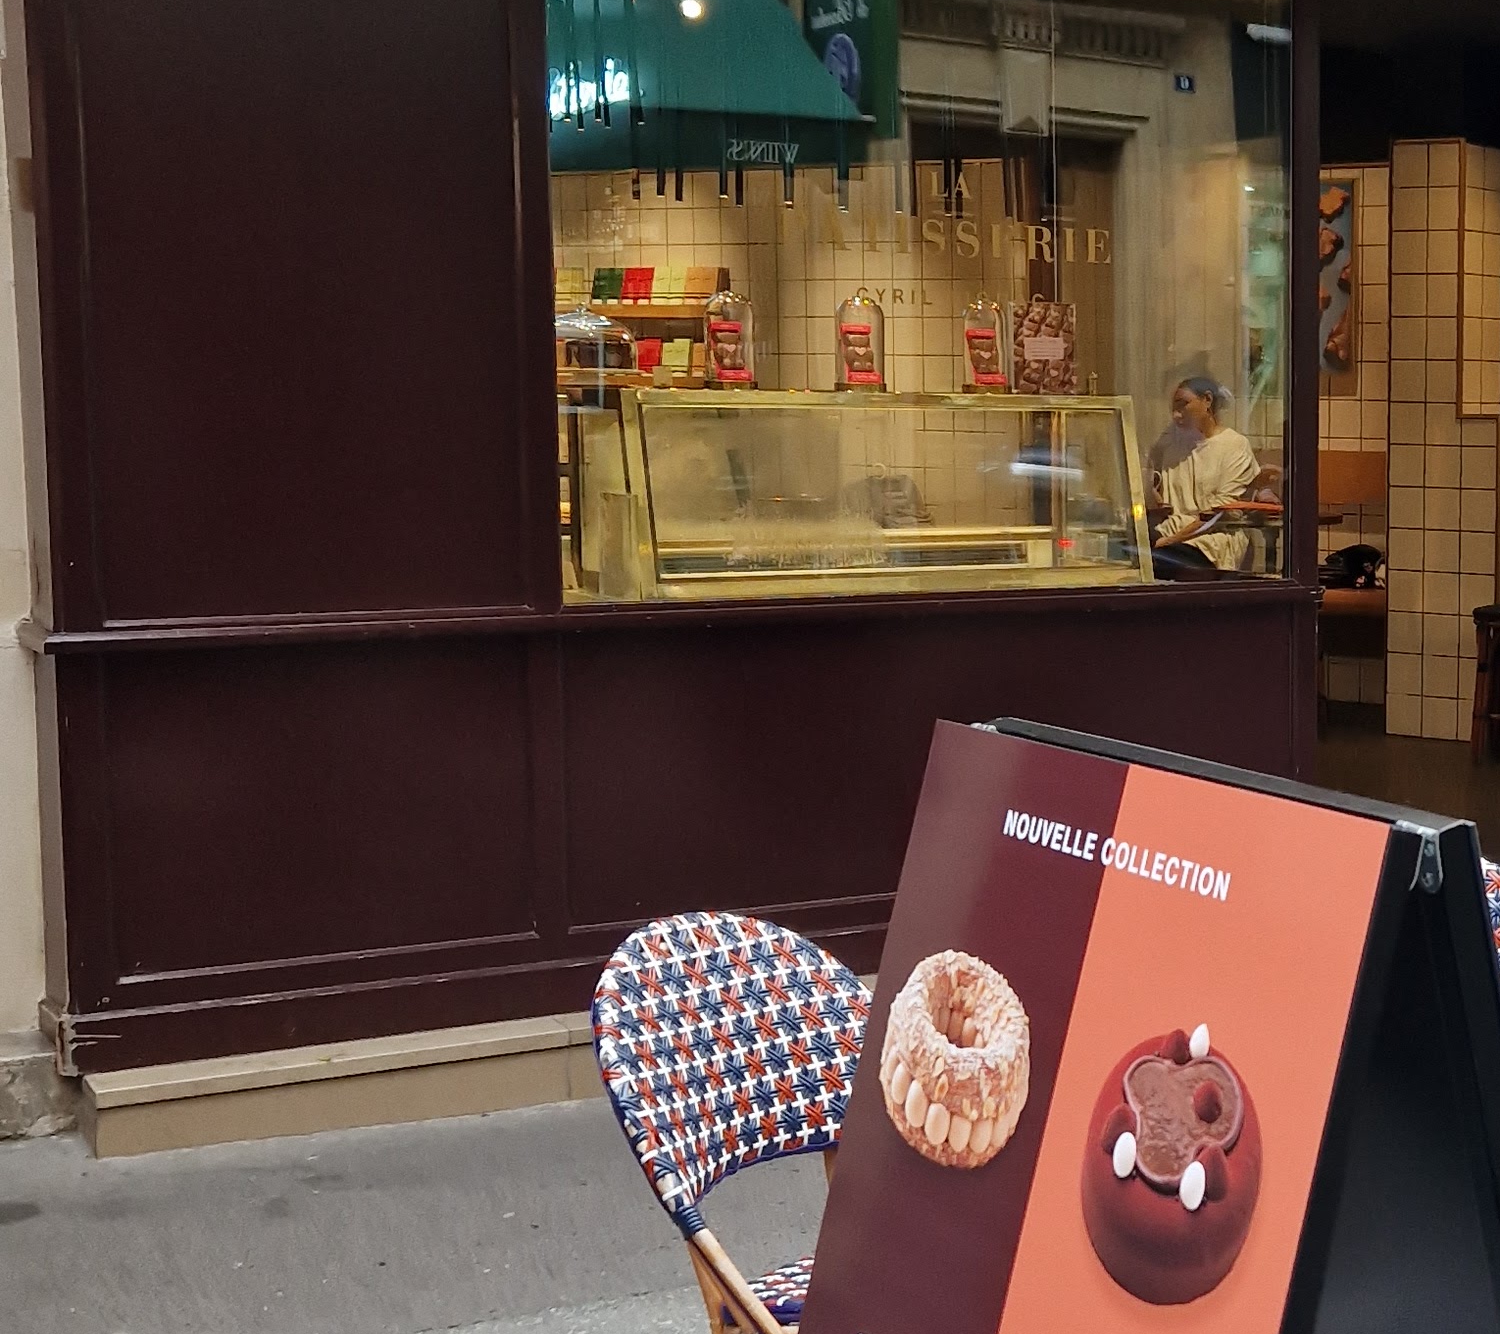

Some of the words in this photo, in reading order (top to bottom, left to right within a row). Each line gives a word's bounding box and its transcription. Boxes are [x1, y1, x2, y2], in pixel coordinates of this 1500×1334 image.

[930, 171, 972, 199] LA
[856, 286, 933, 305] CYRIL
[1003, 809, 1098, 861] NOUVELLE
[1101, 837, 1231, 901] COLLECTION
